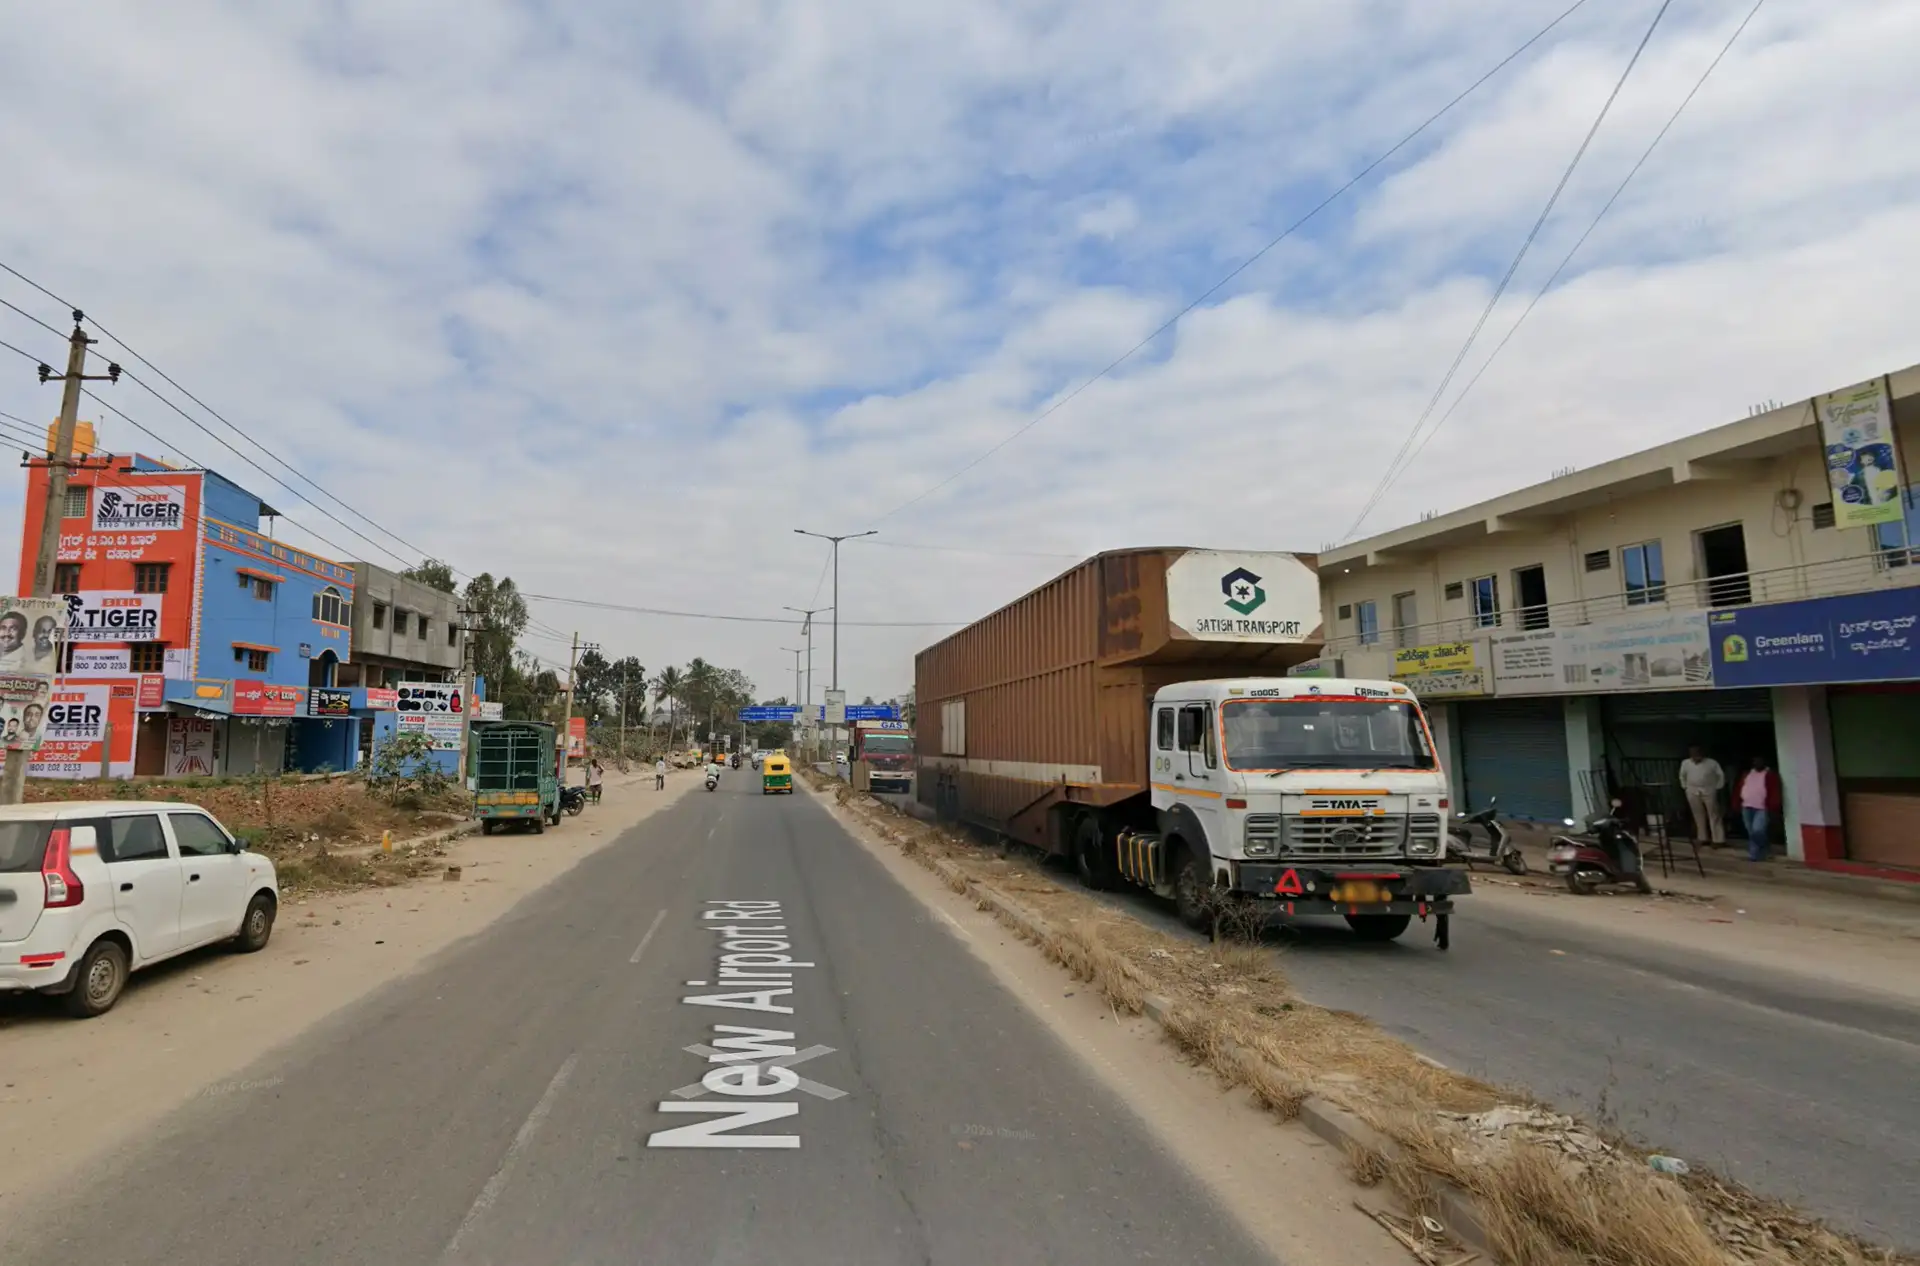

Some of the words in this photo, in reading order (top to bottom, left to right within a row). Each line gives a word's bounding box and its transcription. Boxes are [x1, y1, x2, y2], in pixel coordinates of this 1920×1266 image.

[123, 503, 180, 517] TIGER
[84, 609, 157, 627] TIGER
[1196, 619, 1233, 632] SATISH
[1236, 620, 1301, 635] TRANSPORT
[114, 632, 156, 640] RE-BAR
[1756, 633, 1824, 648] Greenlam
[93, 662, 107, 670] 200
[110, 662, 127, 670] 2233
[1250, 688, 1279, 696] GOODS
[48, 705, 101, 724] GER
[171, 719, 212, 733] EXIDE
[881, 721, 903, 729] GAS
[1329, 800, 1366, 809] TATA
